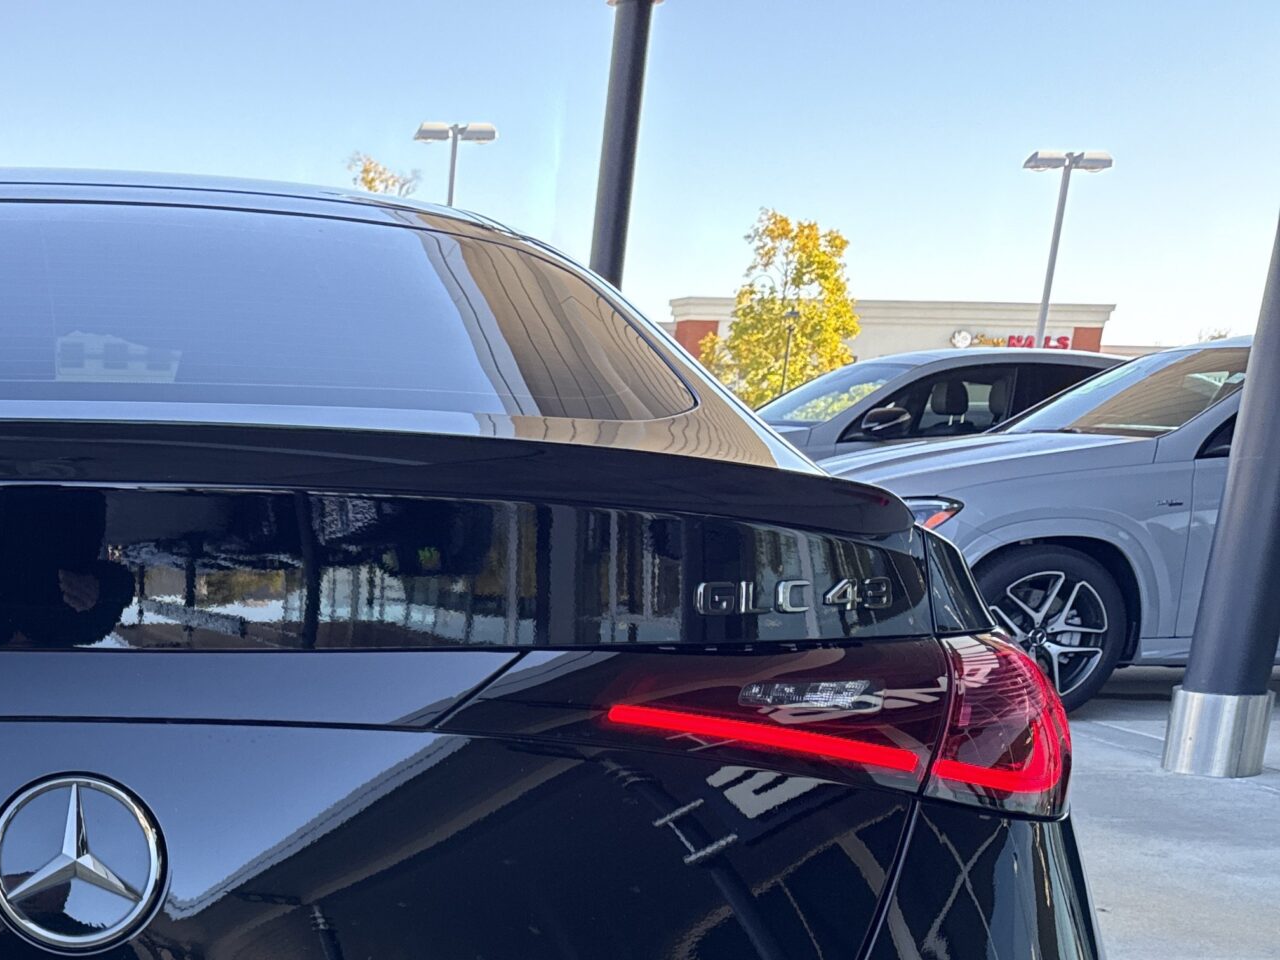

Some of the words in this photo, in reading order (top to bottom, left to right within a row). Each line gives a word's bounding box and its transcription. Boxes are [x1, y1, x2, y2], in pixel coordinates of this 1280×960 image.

[1008, 335, 1070, 349] NALS
[693, 580, 811, 616] GLC
[823, 576, 894, 611] 43
